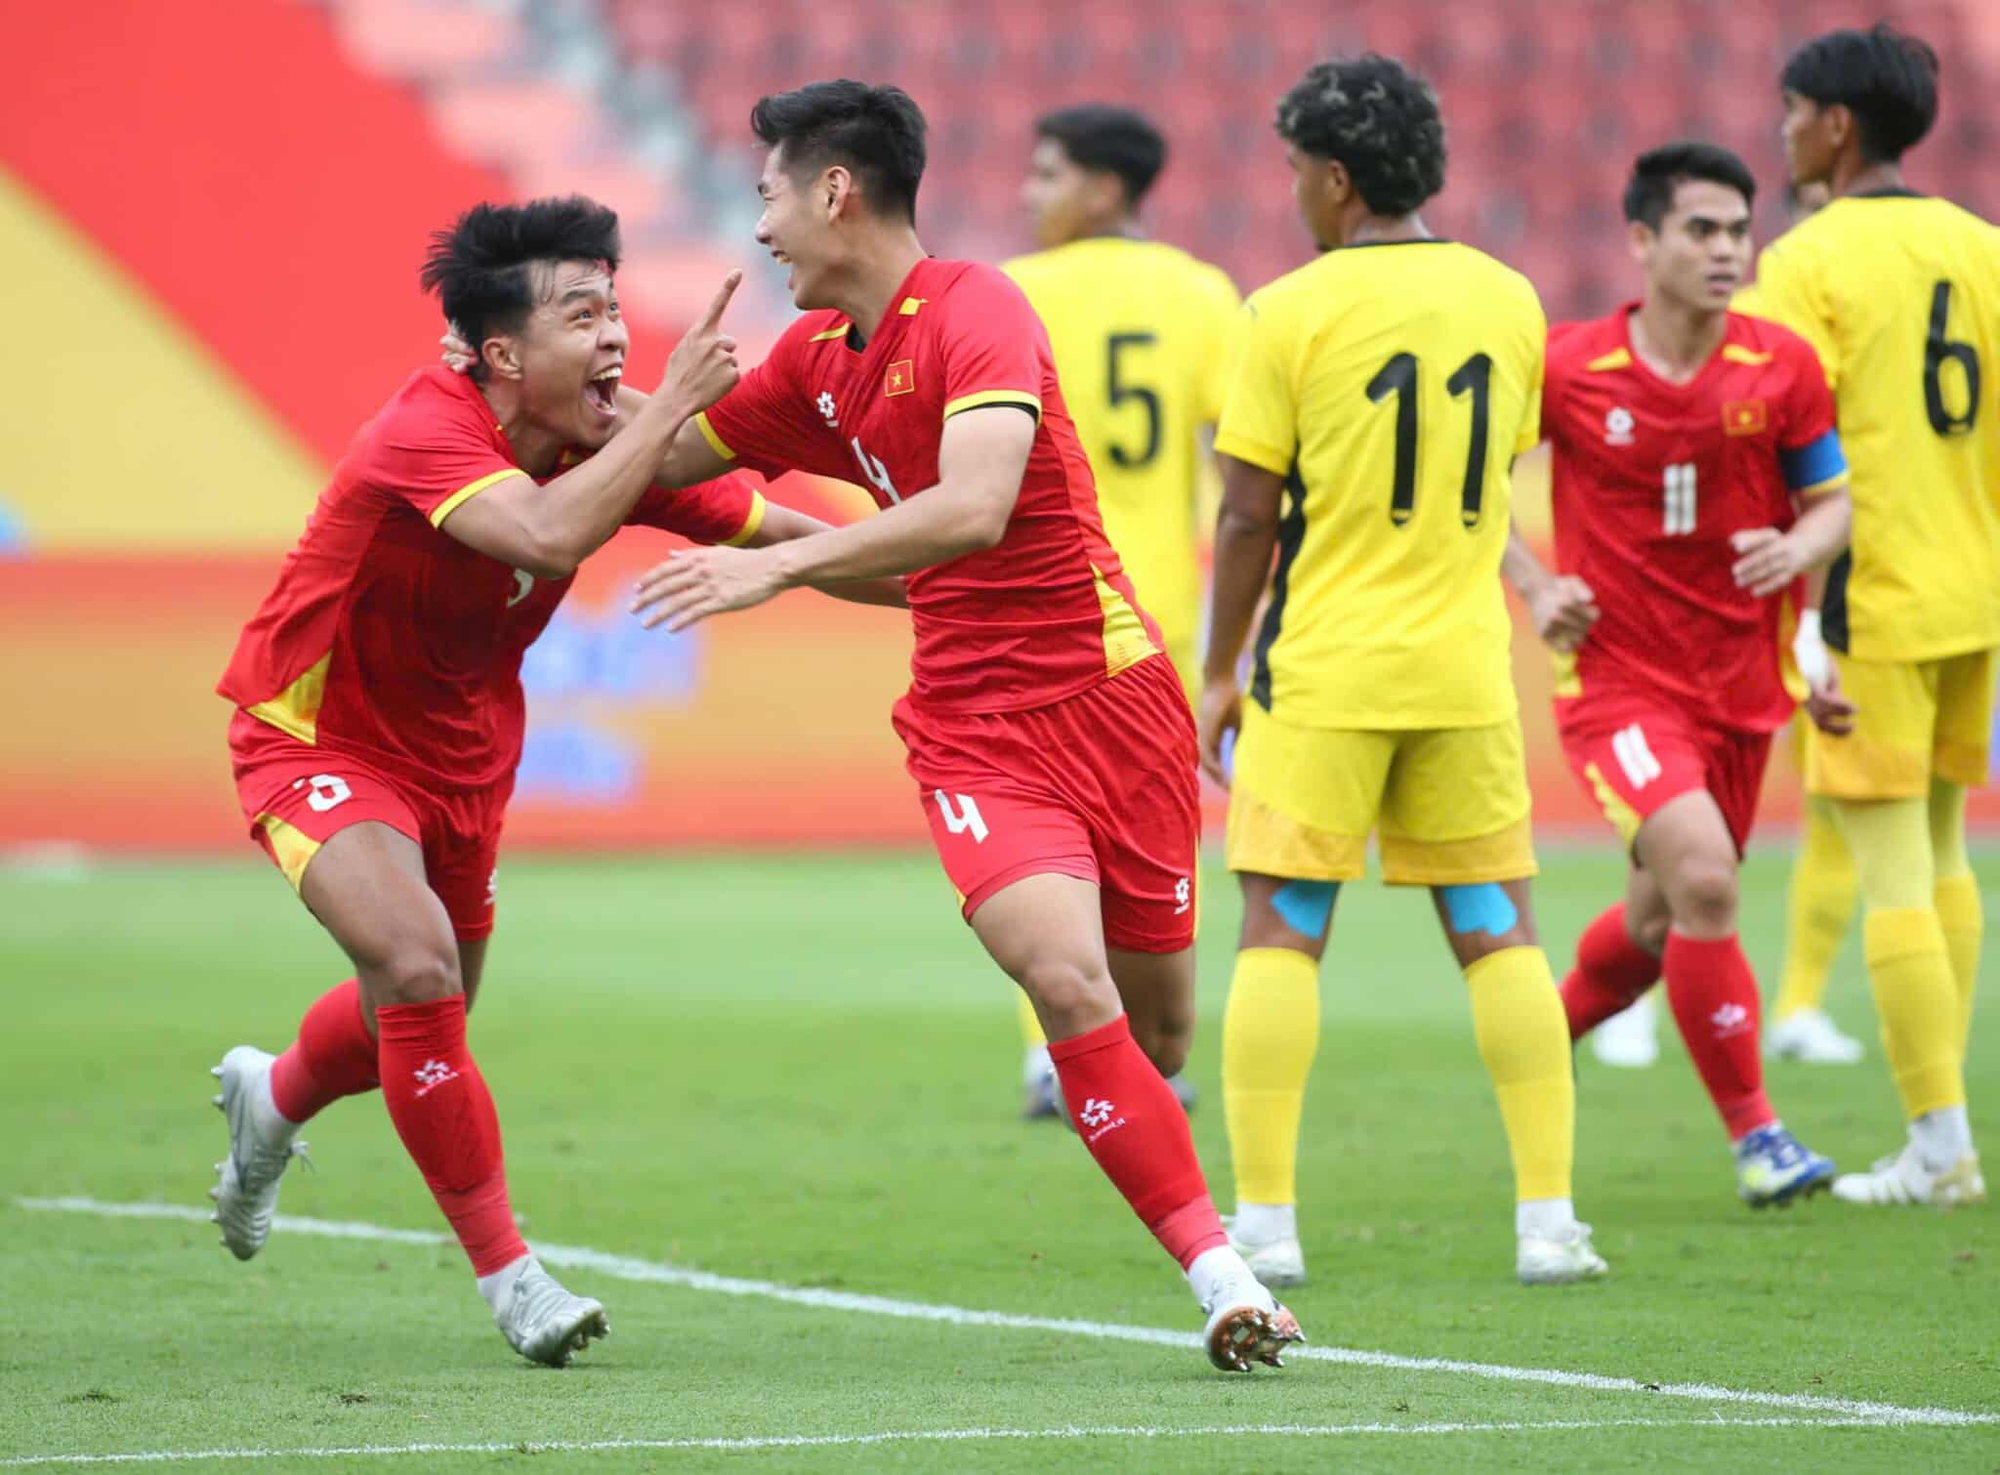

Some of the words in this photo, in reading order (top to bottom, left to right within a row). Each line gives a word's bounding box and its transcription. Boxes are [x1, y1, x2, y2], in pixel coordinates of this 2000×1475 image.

[1924, 280, 1980, 437] 6
[1106, 332, 1162, 467] 5
[851, 436, 902, 505] 4
[1365, 352, 1492, 527] 11
[1663, 463, 1697, 535] 11
[1611, 722, 1662, 791] 11
[934, 788, 990, 844] 4
